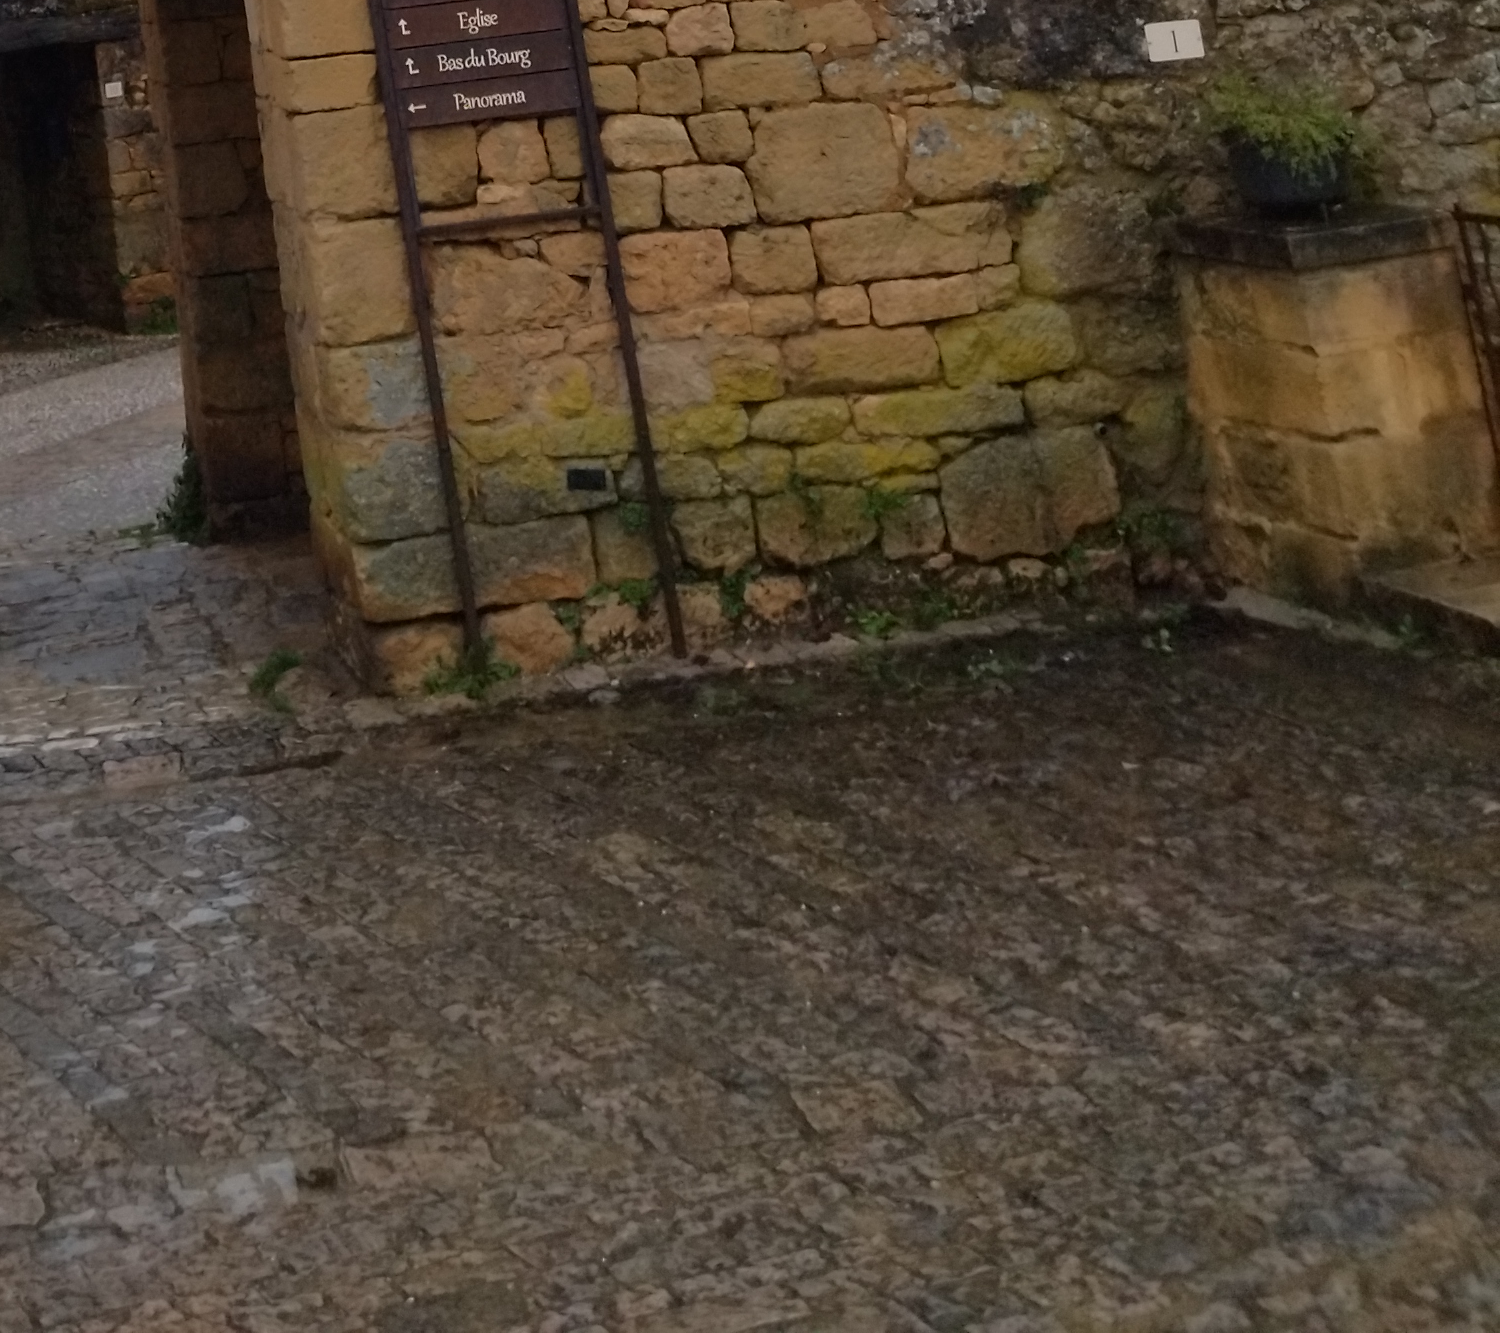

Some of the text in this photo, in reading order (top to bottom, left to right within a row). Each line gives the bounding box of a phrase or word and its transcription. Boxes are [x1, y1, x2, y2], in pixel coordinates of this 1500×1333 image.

[457, 7, 499, 35] Eglise
[1171, 30, 1179, 53] 1
[437, 47, 532, 72] Bas du Bourg
[453, 90, 527, 111] Panorama
